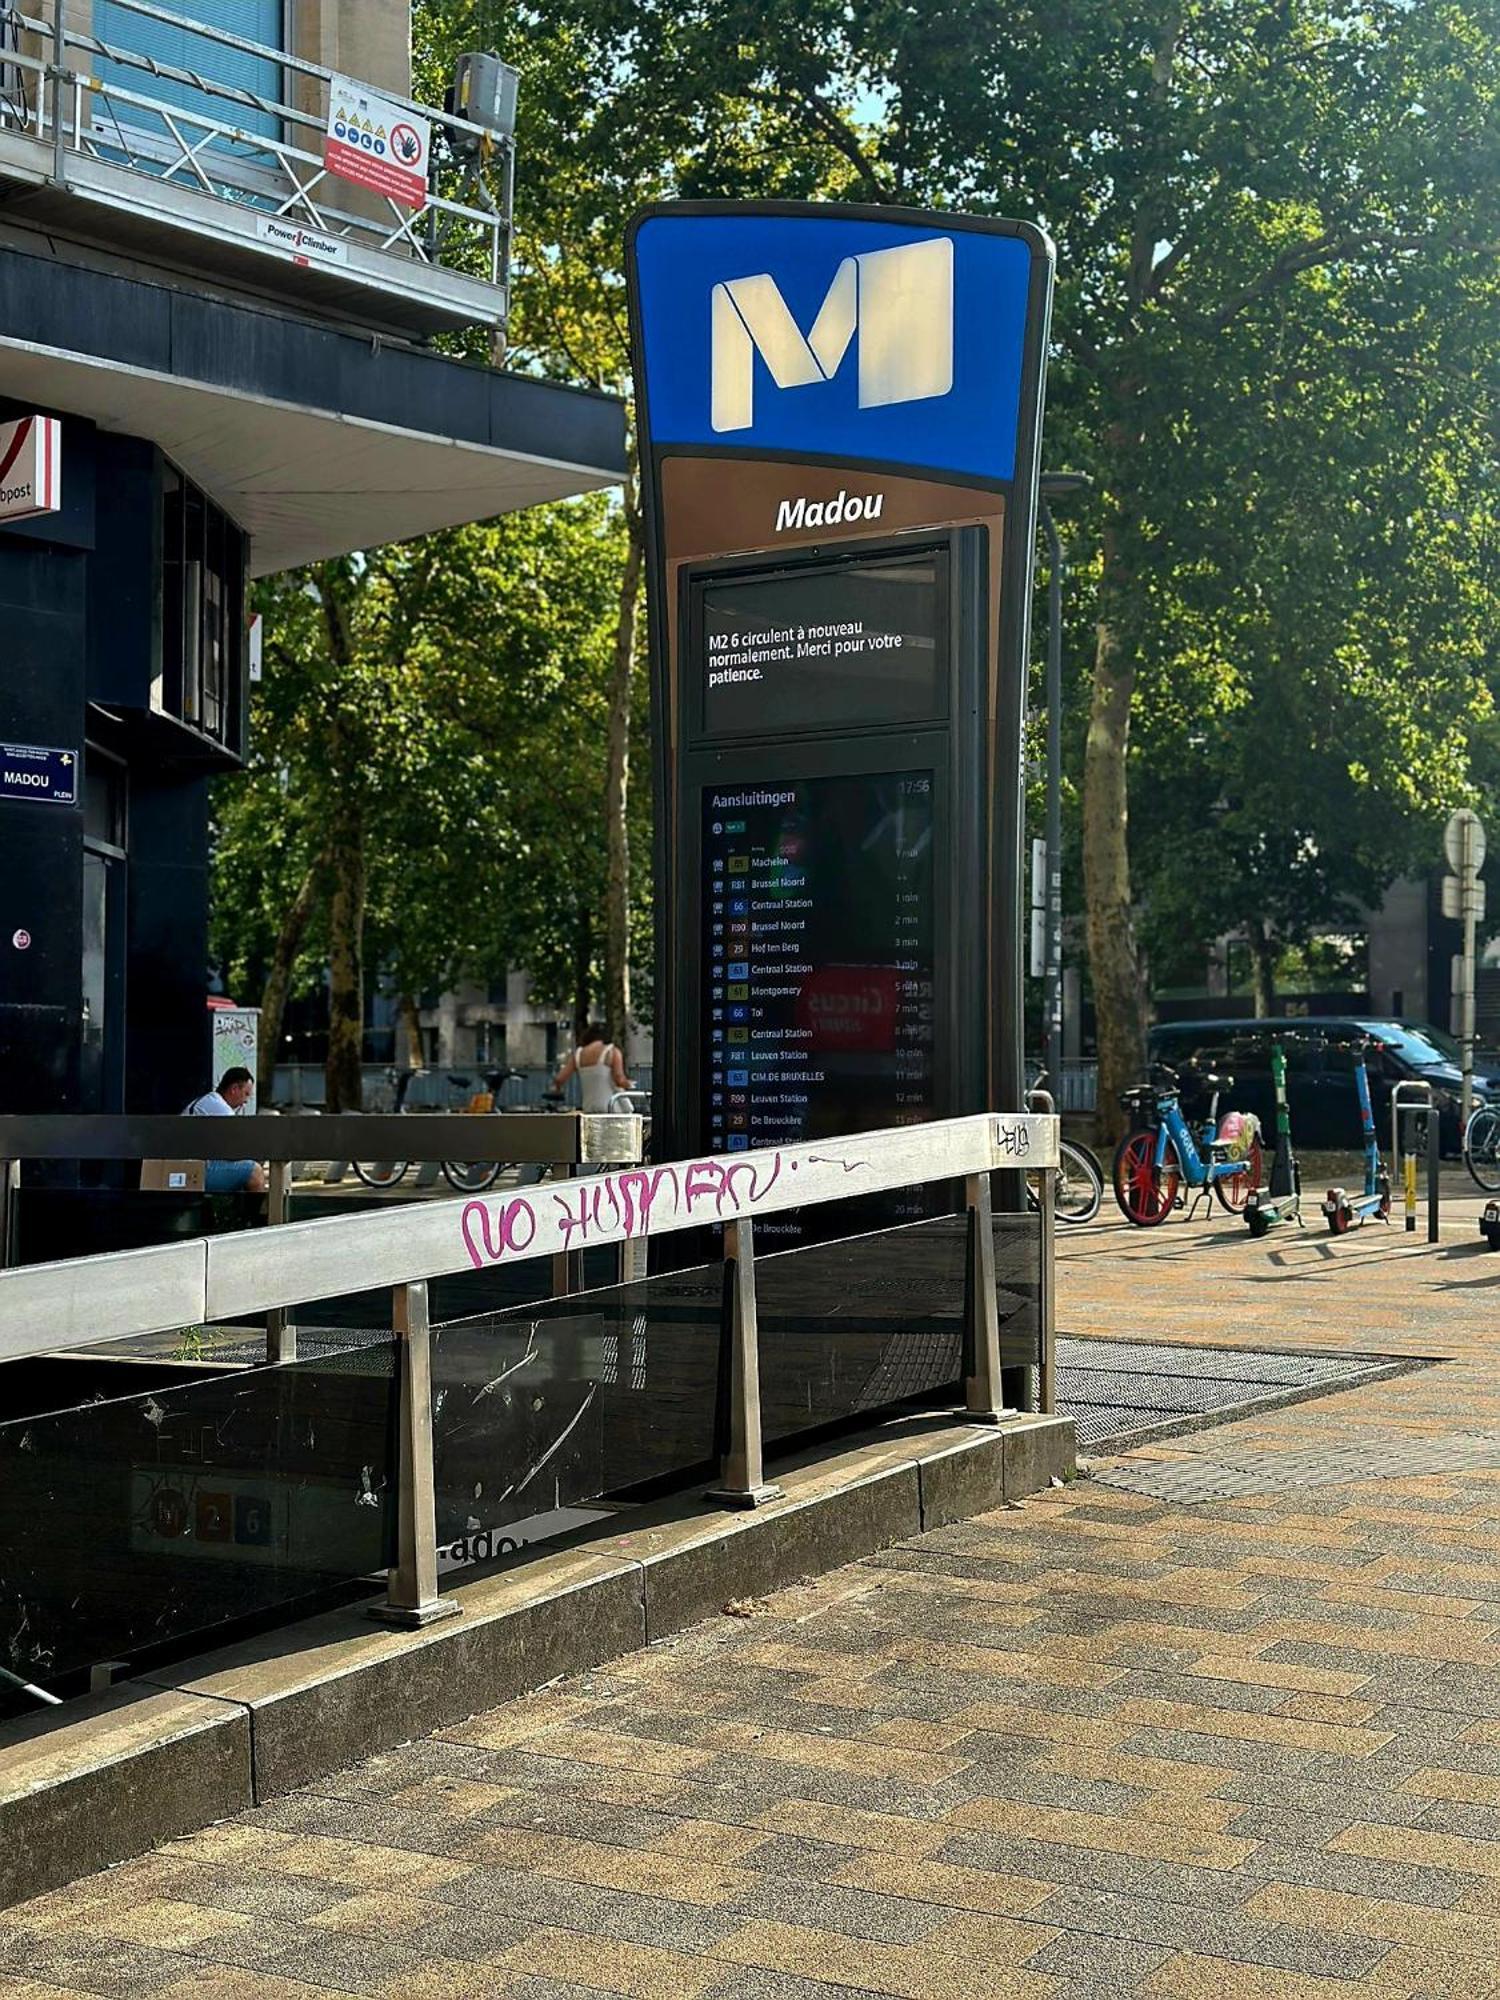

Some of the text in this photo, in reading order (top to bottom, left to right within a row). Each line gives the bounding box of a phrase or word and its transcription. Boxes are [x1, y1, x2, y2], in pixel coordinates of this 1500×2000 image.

[267, 224, 338, 254] Power Climber
[711, 237, 953, 432] M
[775, 490, 883, 531] Madou
[708, 621, 862, 651] M2 6 circulent à nouveau
[708, 633, 902, 668] normalement. Merci pour votre
[708, 667, 763, 688] patience.
[4, 771, 49, 787] MADOU
[54, 790, 72, 799] PLEIN
[712, 791, 795, 807] Aansluitingen
[751, 879, 779, 889] Brussel
[781, 876, 805, 887] Noord
[751, 900, 783, 911] Centraal
[785, 898, 813, 909] Station
[751, 922, 779, 932] Brussel
[781, 920, 805, 930] Noord
[751, 943, 766, 954] Hof
[767, 943, 780, 952] ten
[782, 942, 799, 953] Berg
[751, 965, 783, 974] Centraal
[785, 963, 813, 973] Station
[751, 986, 802, 998] Montgomery
[751, 1007, 763, 1017] Tol
[751, 1029, 783, 1039] Centraal
[785, 1028, 813, 1038] Station
[751, 1051, 778, 1060] Leuven
[780, 1050, 808, 1060] Station
[781, 1071, 824, 1082] BRUXELLES
[751, 1094, 778, 1104] Leuven
[780, 1093, 808, 1104] Station
[751, 1115, 762, 1125] De
[203, 1503, 223, 1530] 2
[247, 1510, 259, 1534] 6
[440, 1531, 528, 1562] ado
